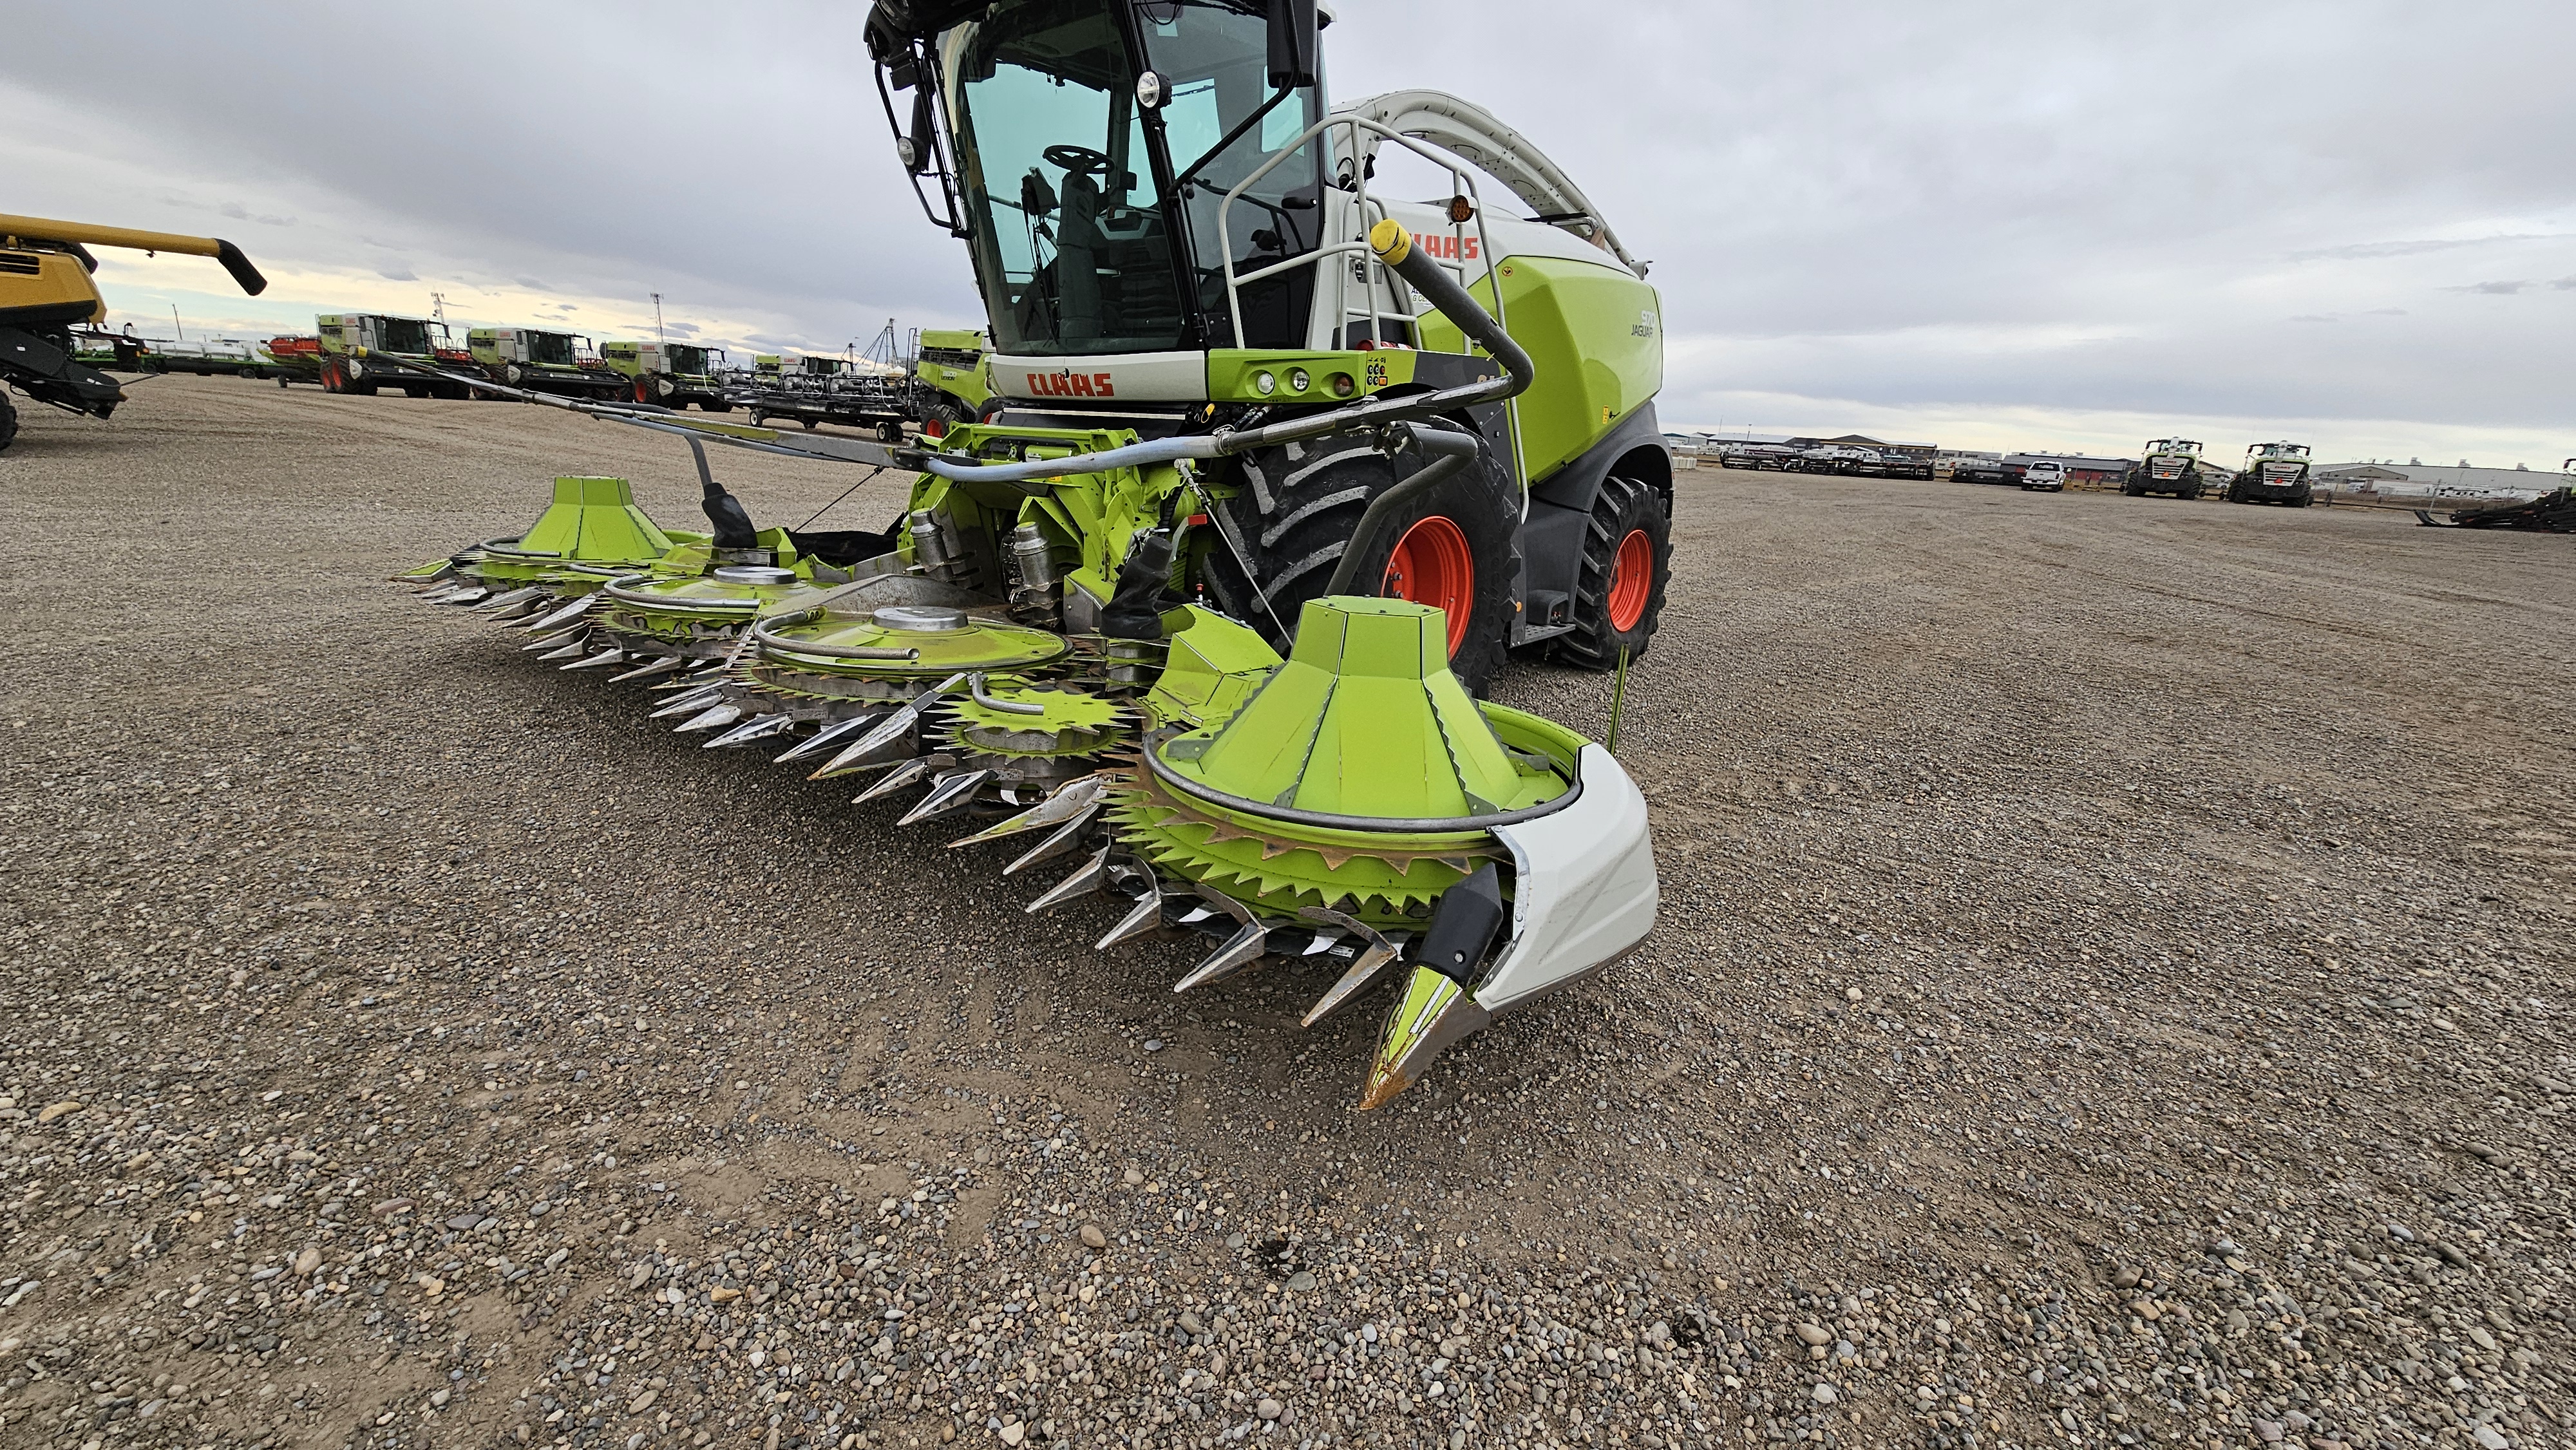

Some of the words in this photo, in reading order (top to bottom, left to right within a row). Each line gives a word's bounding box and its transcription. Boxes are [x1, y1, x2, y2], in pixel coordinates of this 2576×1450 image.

[1409, 233, 1478, 258] AAS
[1642, 310, 1656, 327] 970
[1631, 324, 1653, 339] JAGUAR
[1027, 373, 1115, 397] CLAAS
